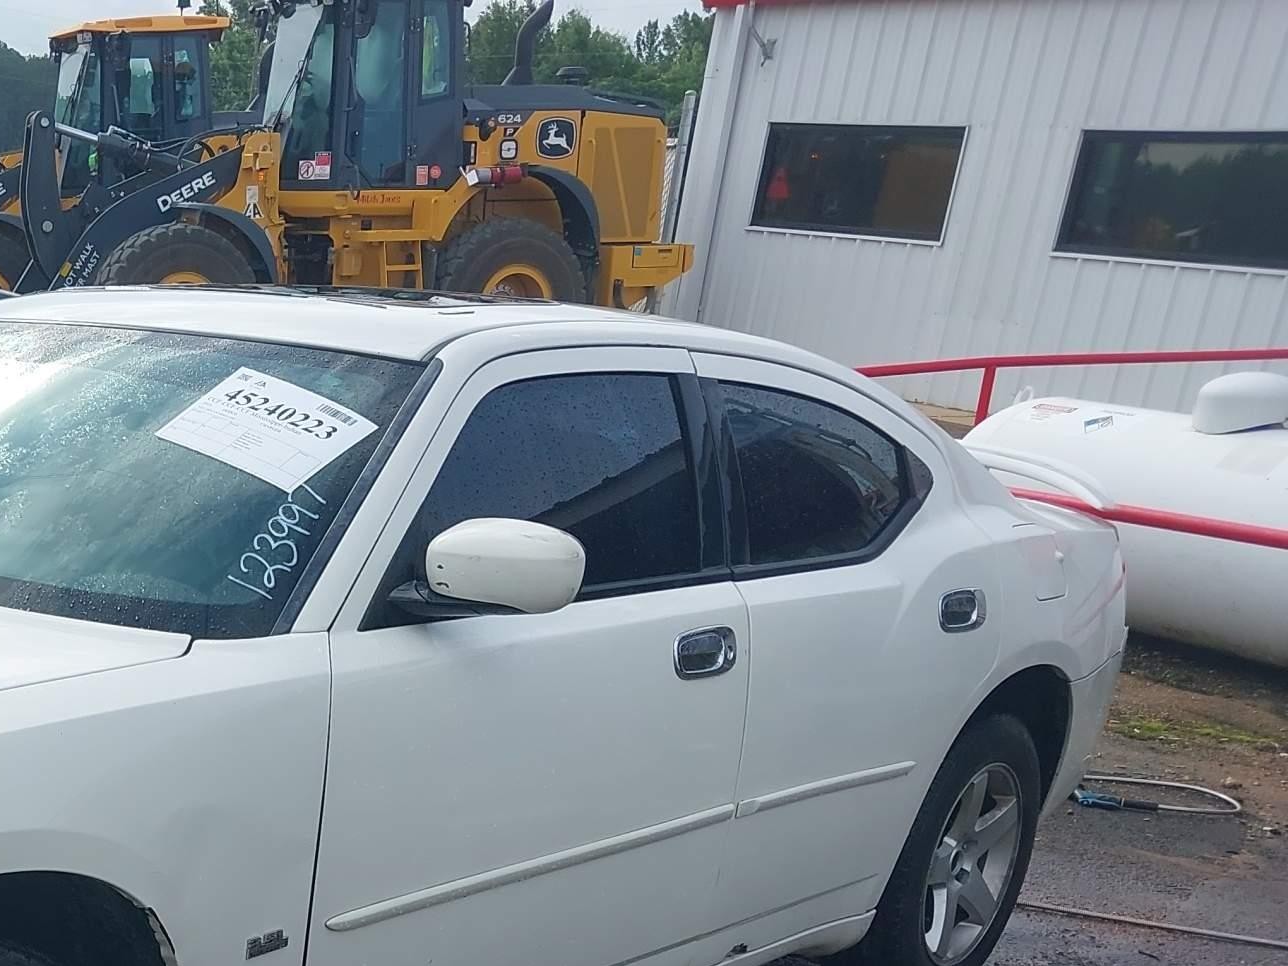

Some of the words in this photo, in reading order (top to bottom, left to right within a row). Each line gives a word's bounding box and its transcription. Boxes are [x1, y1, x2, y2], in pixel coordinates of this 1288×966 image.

[497, 114, 522, 124] 624
[506, 128, 514, 136] P
[156, 171, 217, 213] DEERE
[73, 242, 94, 270] WALK
[82, 250, 100, 278] MAST
[224, 388, 338, 440] 45240223
